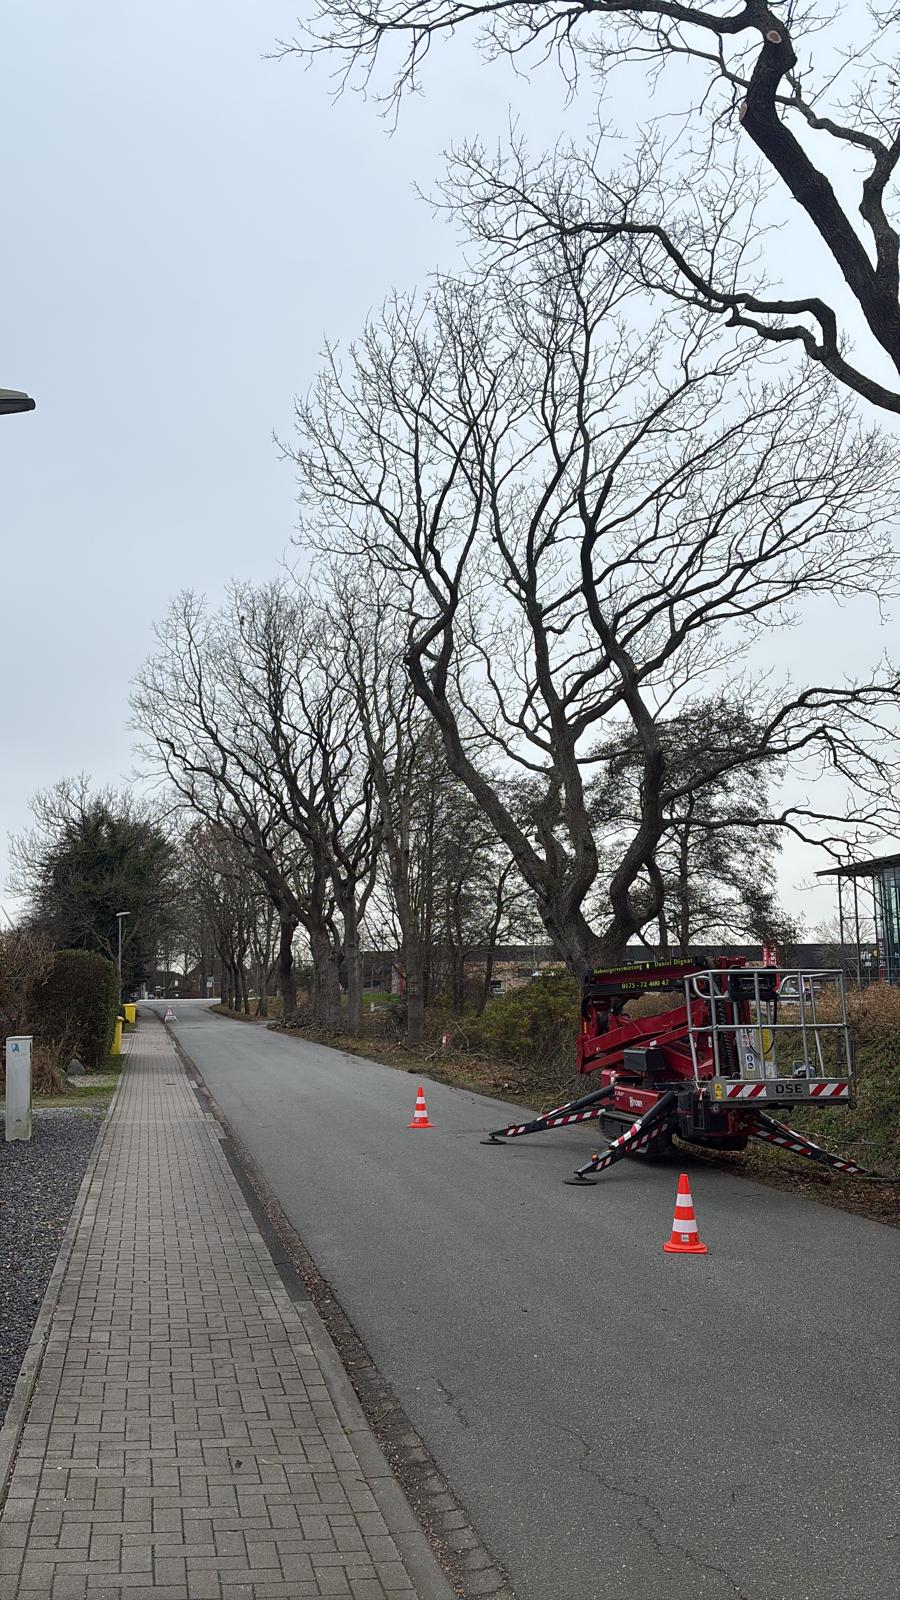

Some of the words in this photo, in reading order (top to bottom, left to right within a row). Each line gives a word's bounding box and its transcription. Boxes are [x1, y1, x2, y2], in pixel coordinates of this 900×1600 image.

[654, 959, 672, 968] Daniel
[621, 981, 635, 989] 0175
[775, 1084, 803, 1094] DSE
